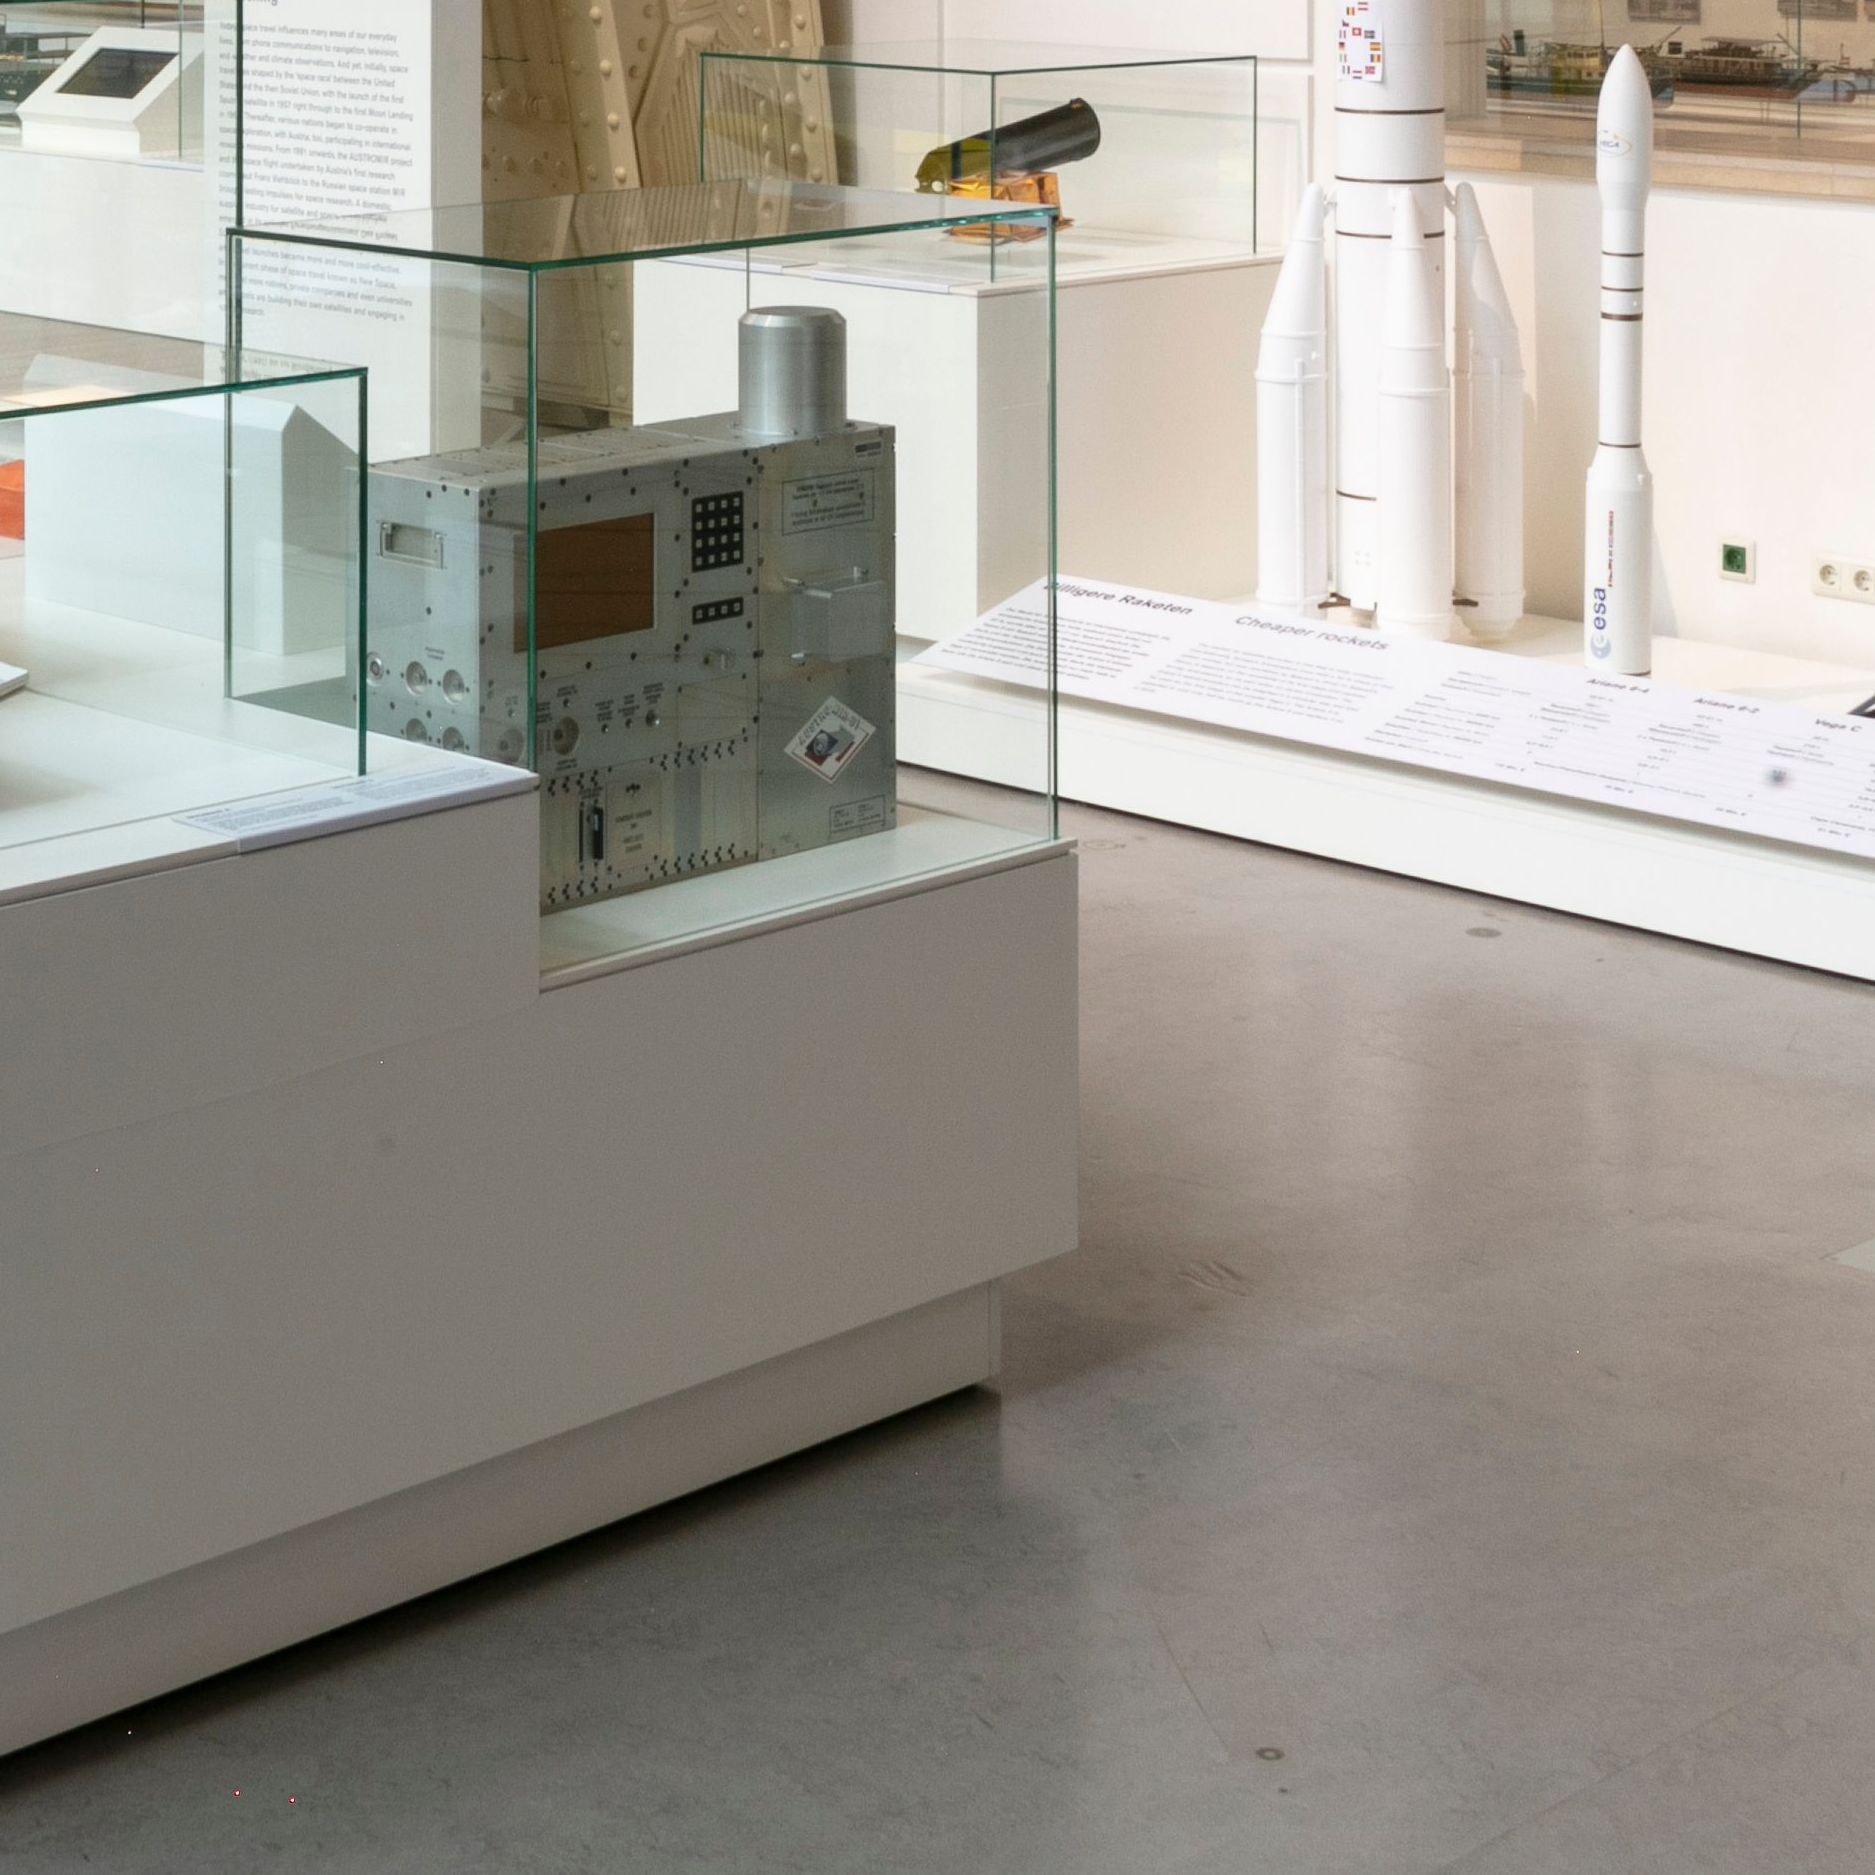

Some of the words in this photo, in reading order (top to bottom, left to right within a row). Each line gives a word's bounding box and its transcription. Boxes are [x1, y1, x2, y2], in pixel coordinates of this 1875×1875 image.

[1119, 594, 1193, 616] Raketen
[1594, 587, 1607, 630] esa
[1234, 615, 1317, 638] Cheaper
[1317, 629, 1390, 651] rockets
[1815, 719, 1846, 731] Vega
